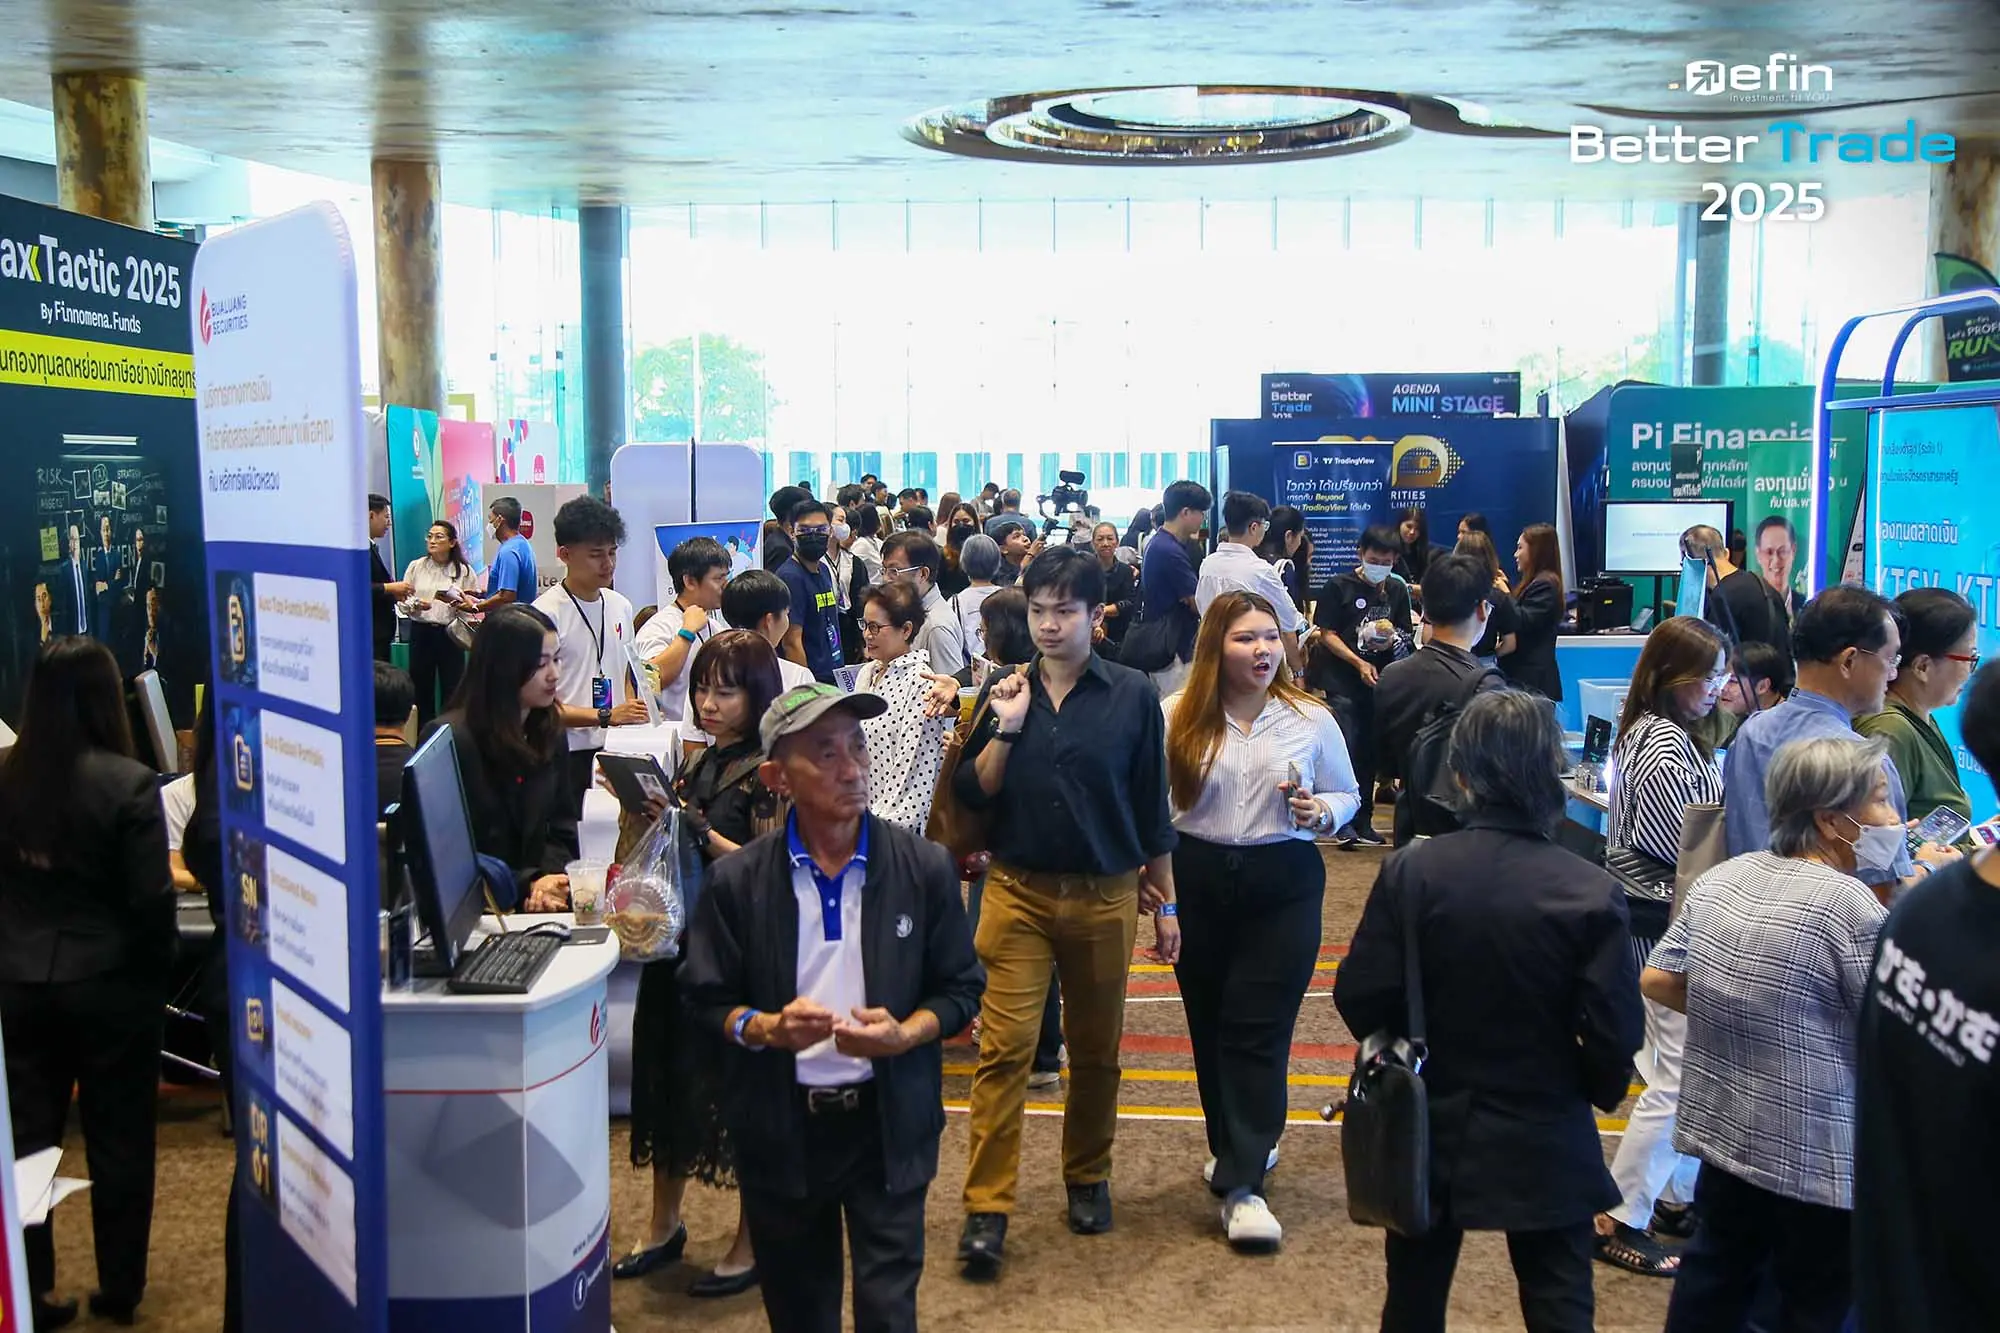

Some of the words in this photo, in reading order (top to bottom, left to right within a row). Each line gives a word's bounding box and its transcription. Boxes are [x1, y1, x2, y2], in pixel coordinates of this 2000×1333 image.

[125, 255, 182, 309] 2025
[40, 303, 53, 324] By
[1392, 384, 1441, 394] AGENDA
[1271, 391, 1313, 401] Better
[1272, 401, 1312, 412] Trade
[1392, 396, 1435, 413] MINI
[1440, 395, 1505, 413] STAGE
[1632, 422, 1662, 449] Pi
[1334, 457, 1375, 466] TradingView
[36, 467, 63, 485] RISK
[1286, 479, 1317, 492] ไวกว่า
[1319, 478, 1383, 492] ได้เปรียบกว่า
[1315, 493, 1345, 502] Beyond
[1302, 503, 1348, 512] TradingView
[1391, 501, 1426, 509] LIMITED
